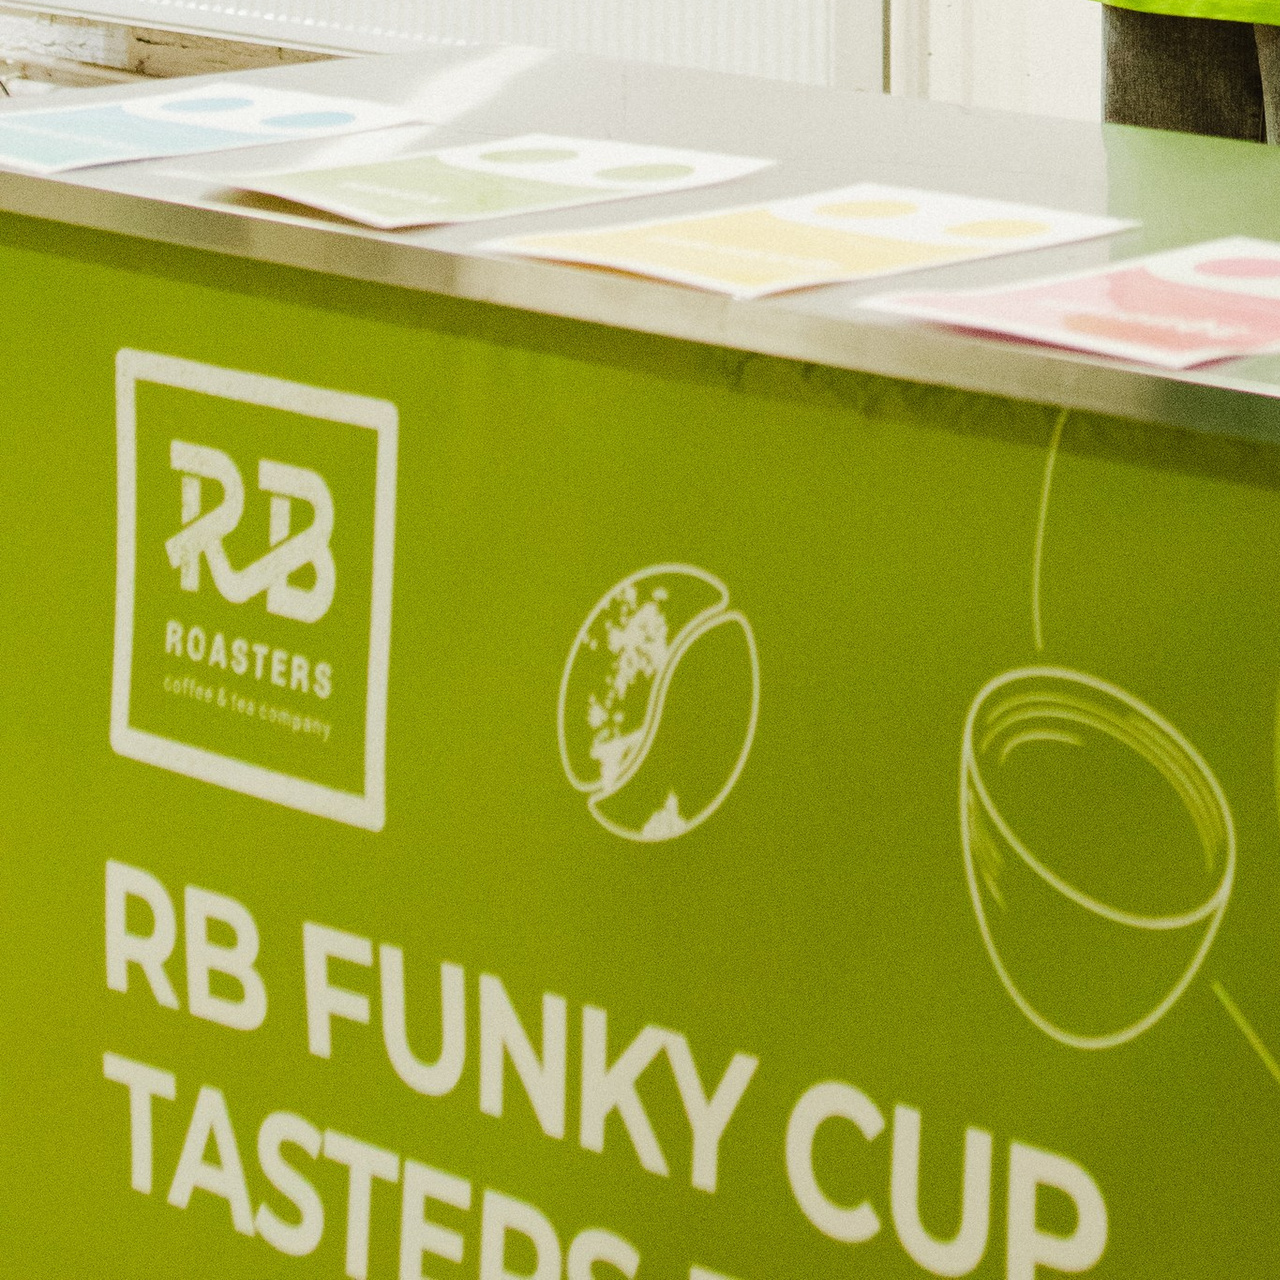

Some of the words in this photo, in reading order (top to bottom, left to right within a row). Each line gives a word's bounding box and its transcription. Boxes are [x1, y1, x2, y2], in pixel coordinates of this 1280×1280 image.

[164, 439, 337, 625] RB
[163, 676, 213, 704] coffee
[216, 687, 228, 708] &
[230, 692, 255, 717] tea
[258, 703, 332, 742] company
[164, 619, 333, 700] ROASTERS
[104, 857, 269, 1034] RB
[302, 919, 760, 1195] FUNKY
[784, 1078, 1109, 1280] CUP
